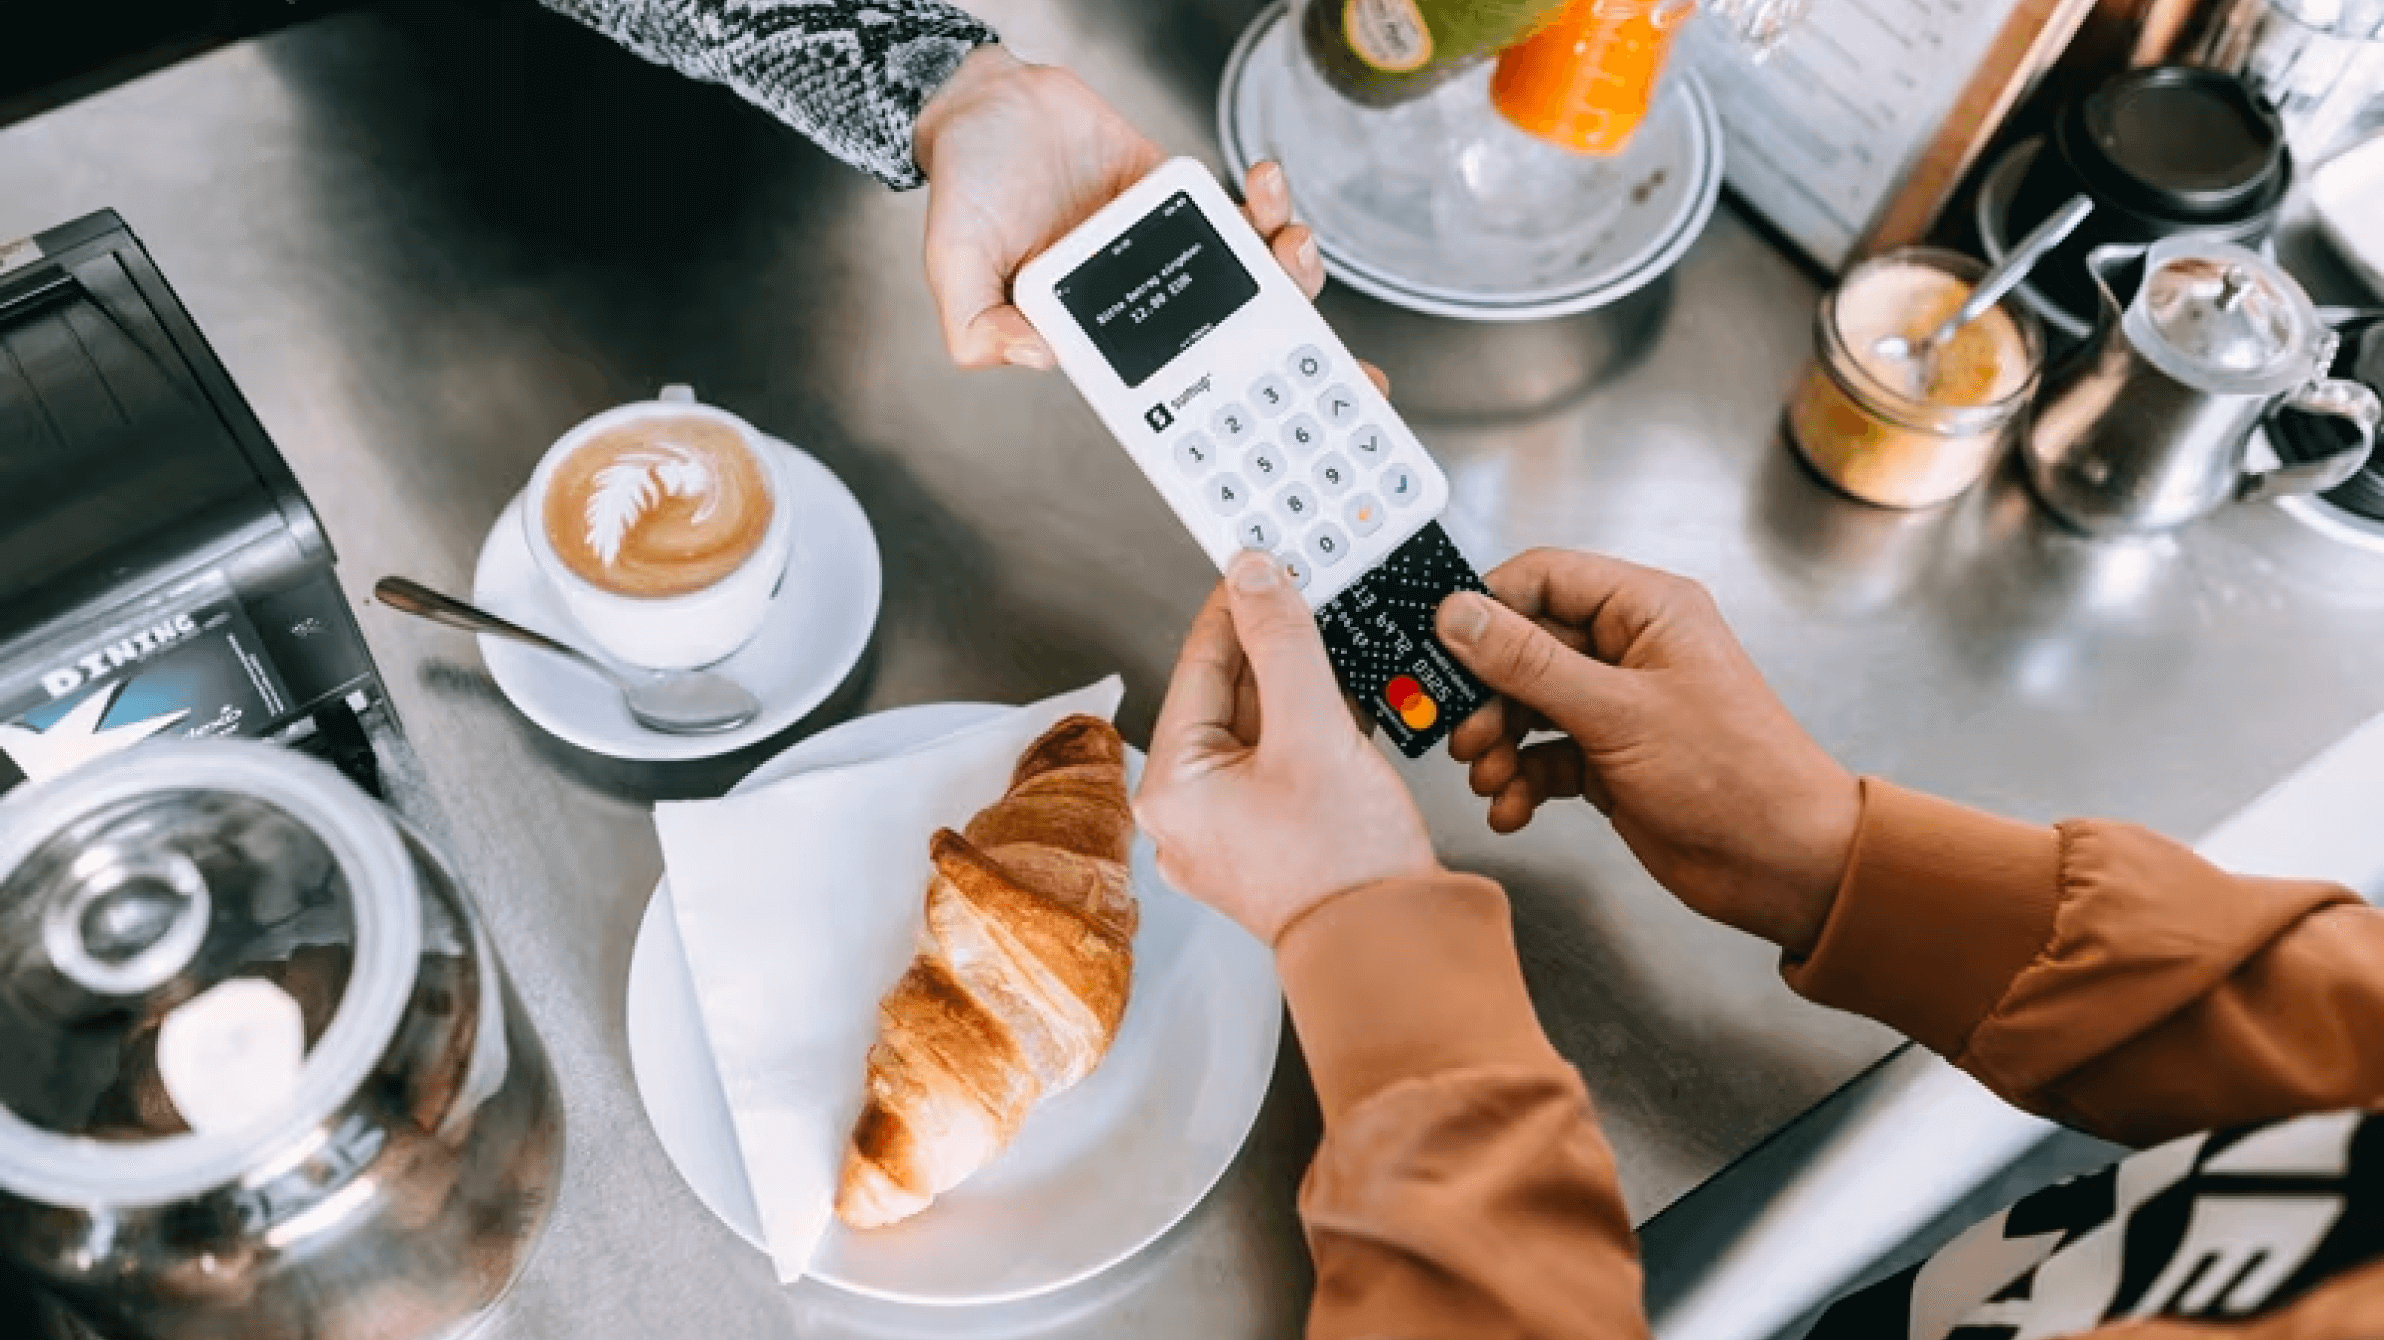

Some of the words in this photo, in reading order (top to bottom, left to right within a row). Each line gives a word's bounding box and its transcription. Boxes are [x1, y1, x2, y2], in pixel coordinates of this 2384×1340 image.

[1224, 414, 1243, 434] 2
[1262, 385, 1280, 405] 3
[1256, 456, 1274, 473] 5
[1295, 426, 1311, 443] 6
[1286, 495, 1303, 514] 8
[1325, 466, 1343, 485] 9
[1318, 534, 1336, 553] 0
[41, 612, 196, 699] DINING
